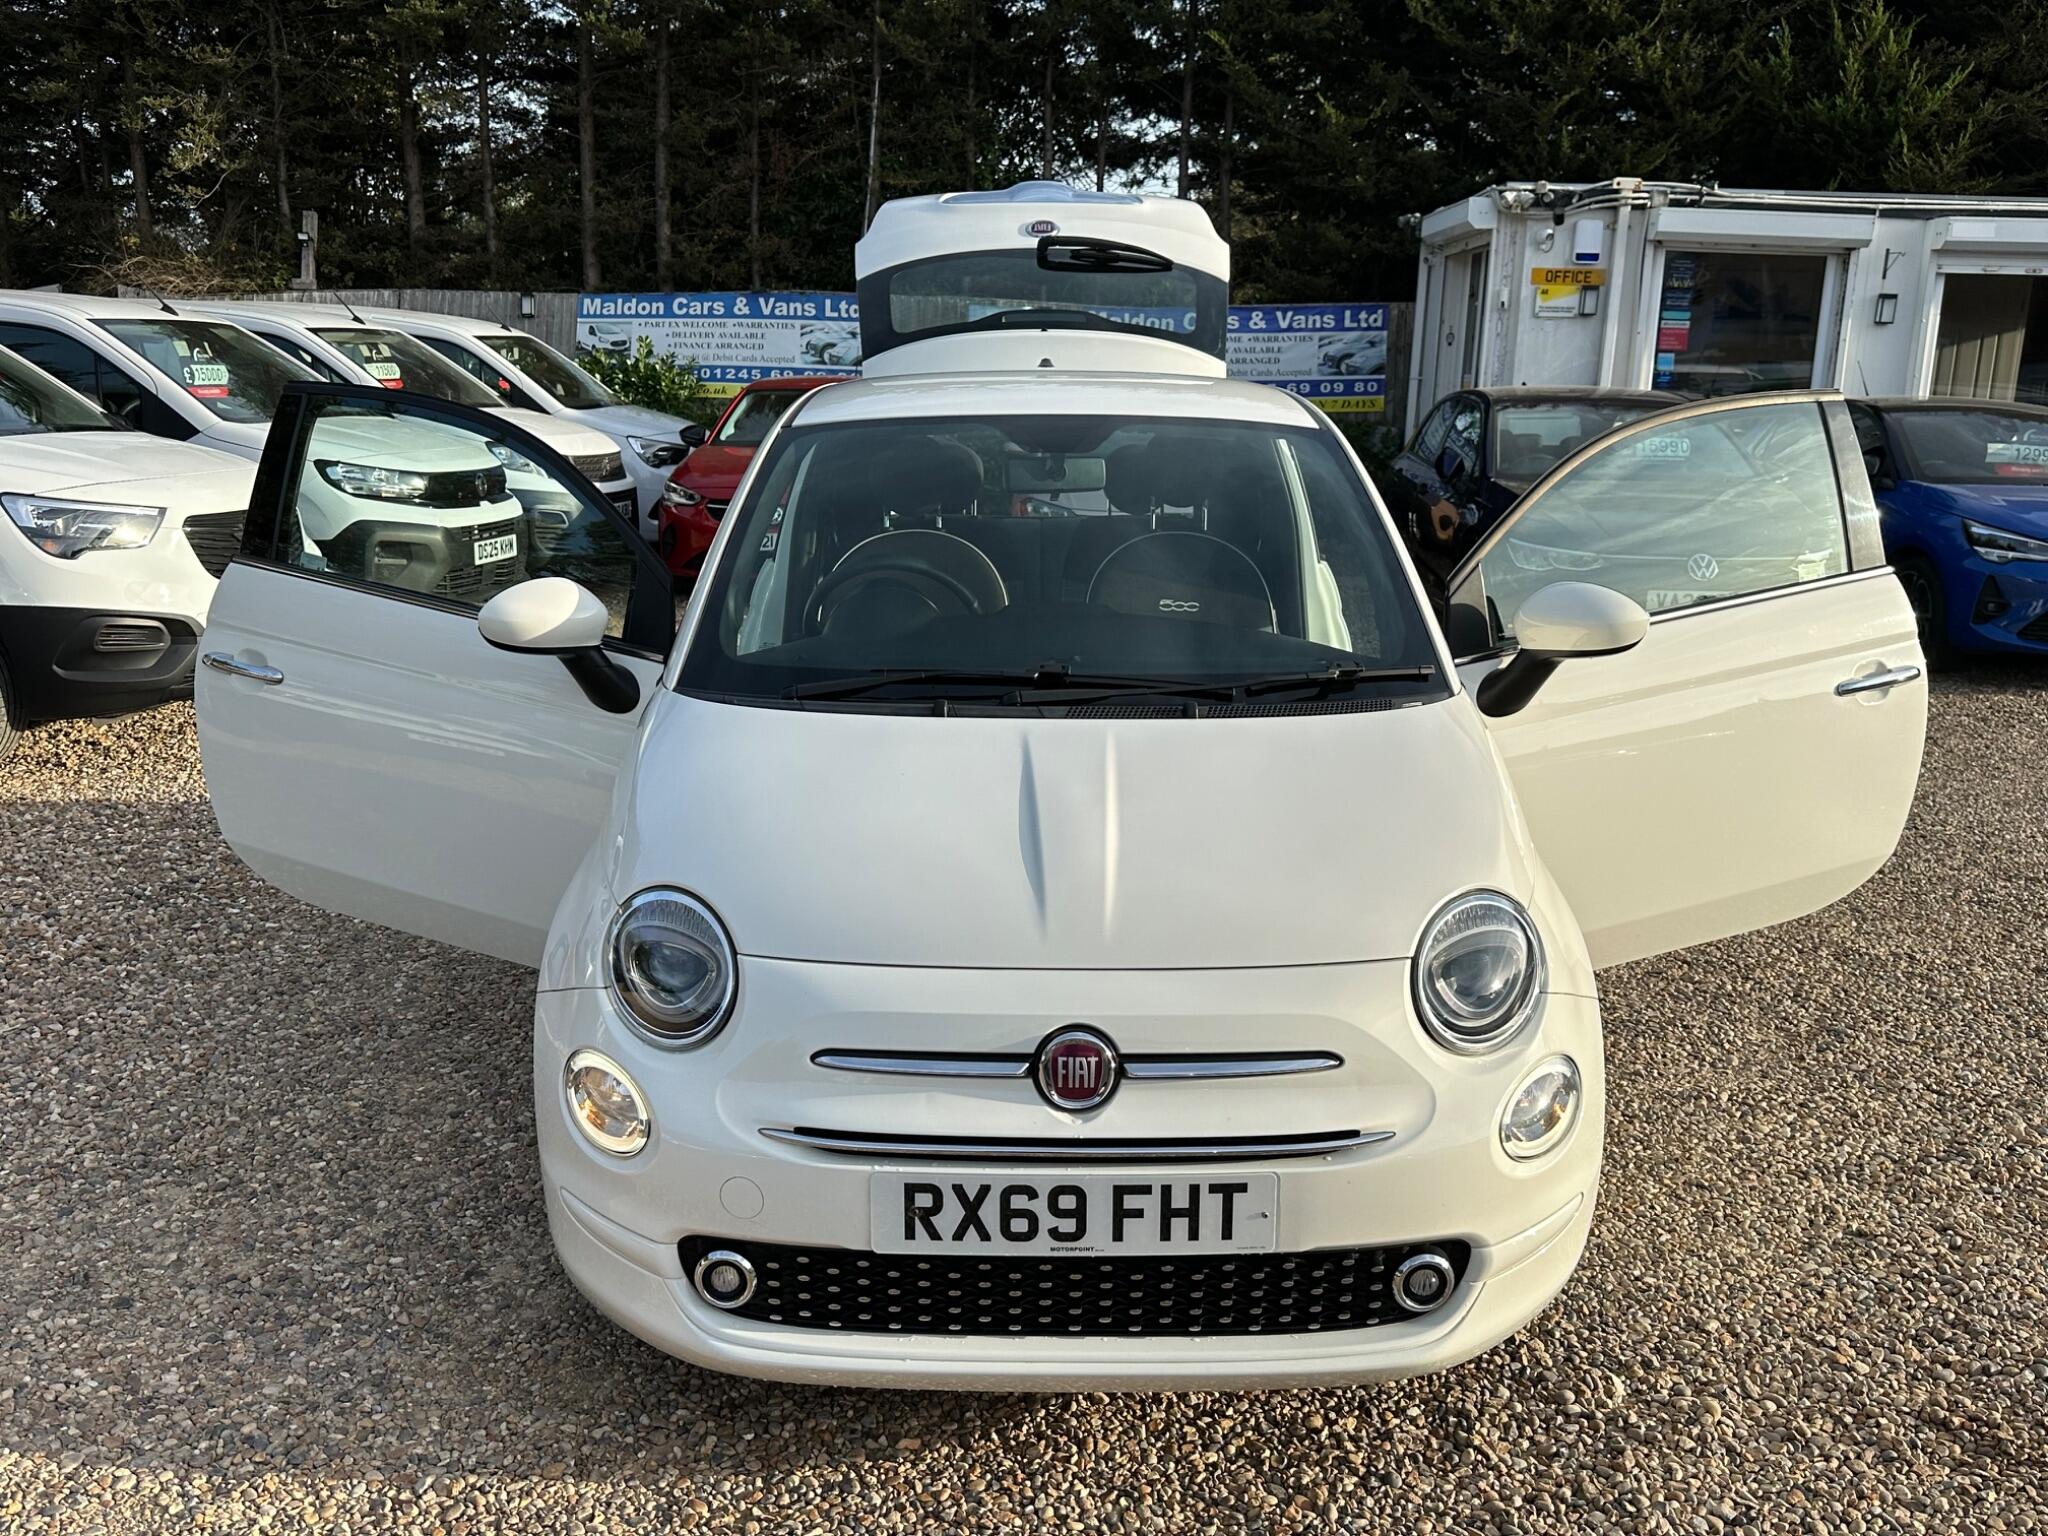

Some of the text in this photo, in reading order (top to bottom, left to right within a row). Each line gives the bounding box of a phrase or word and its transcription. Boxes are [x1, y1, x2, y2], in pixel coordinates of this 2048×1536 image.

[1545, 270, 1593, 283] OFFICE
[583, 298, 664, 315] Maldon
[672, 297, 726, 316] Cars
[733, 297, 751, 315] &
[759, 297, 817, 316] Vans
[644, 321, 665, 329] PART
[682, 321, 728, 329] WELCOME
[1249, 311, 1267, 329] &
[1276, 311, 1336, 329] Vans
[1344, 309, 1383, 328] Ltd
[717, 332, 766, 340] AVAILABLE
[674, 342, 711, 350] FINANCE
[1232, 346, 1283, 354] AVAILABLE
[712, 353, 734, 362] Debit
[735, 353, 758, 362] Cards
[759, 354, 796, 364] Accepted
[1275, 368, 1313, 377] Accepted
[1286, 381, 1378, 394] 69 09 80
[1341, 399, 1377, 408] DAYS
[478, 541, 498, 560] DS25
[1058, 1056, 1099, 1088] FIAT
[904, 1182, 1248, 1243] RX69 FHT
